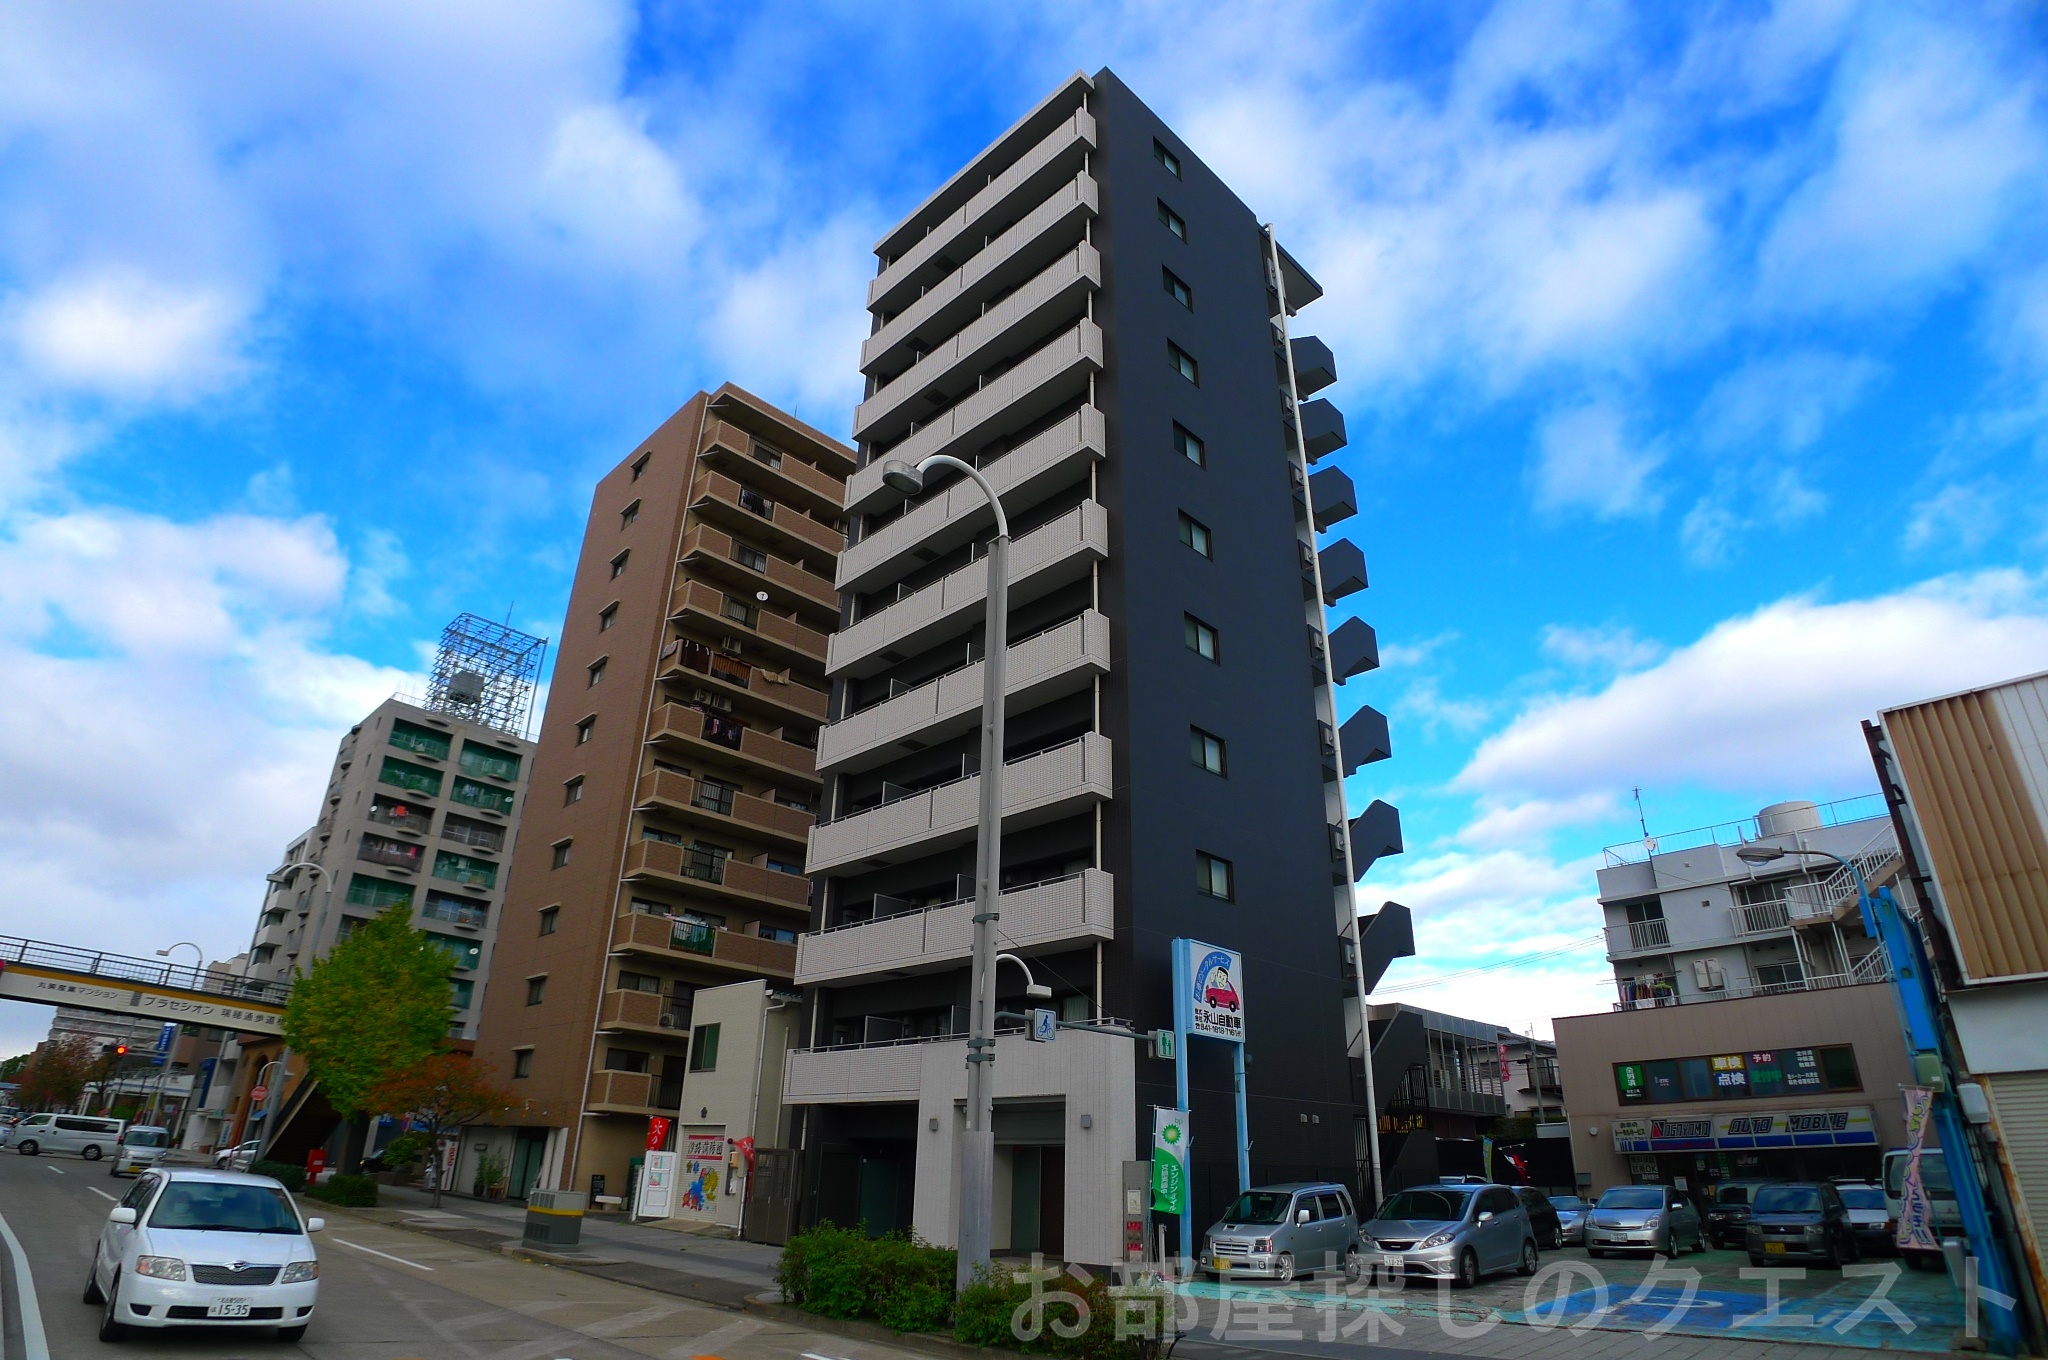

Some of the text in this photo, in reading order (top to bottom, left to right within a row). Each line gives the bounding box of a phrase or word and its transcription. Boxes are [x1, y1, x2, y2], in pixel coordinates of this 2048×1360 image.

[1203, 1010, 1242, 1029] 永山自動車
[1714, 1056, 1742, 1069] 車検
[1752, 1053, 1772, 1062] 予約
[1718, 1072, 1746, 1086] 点検
[1750, 1069, 1782, 1083] 受付中
[1728, 1116, 1774, 1135] AUTO
[1785, 1112, 1849, 1133] MOBILE
[650, 1120, 663, 1151] 火の
[1169, 1164, 1178, 1212] エンジンオイル
[218, 1304, 249, 1315] 15-35
